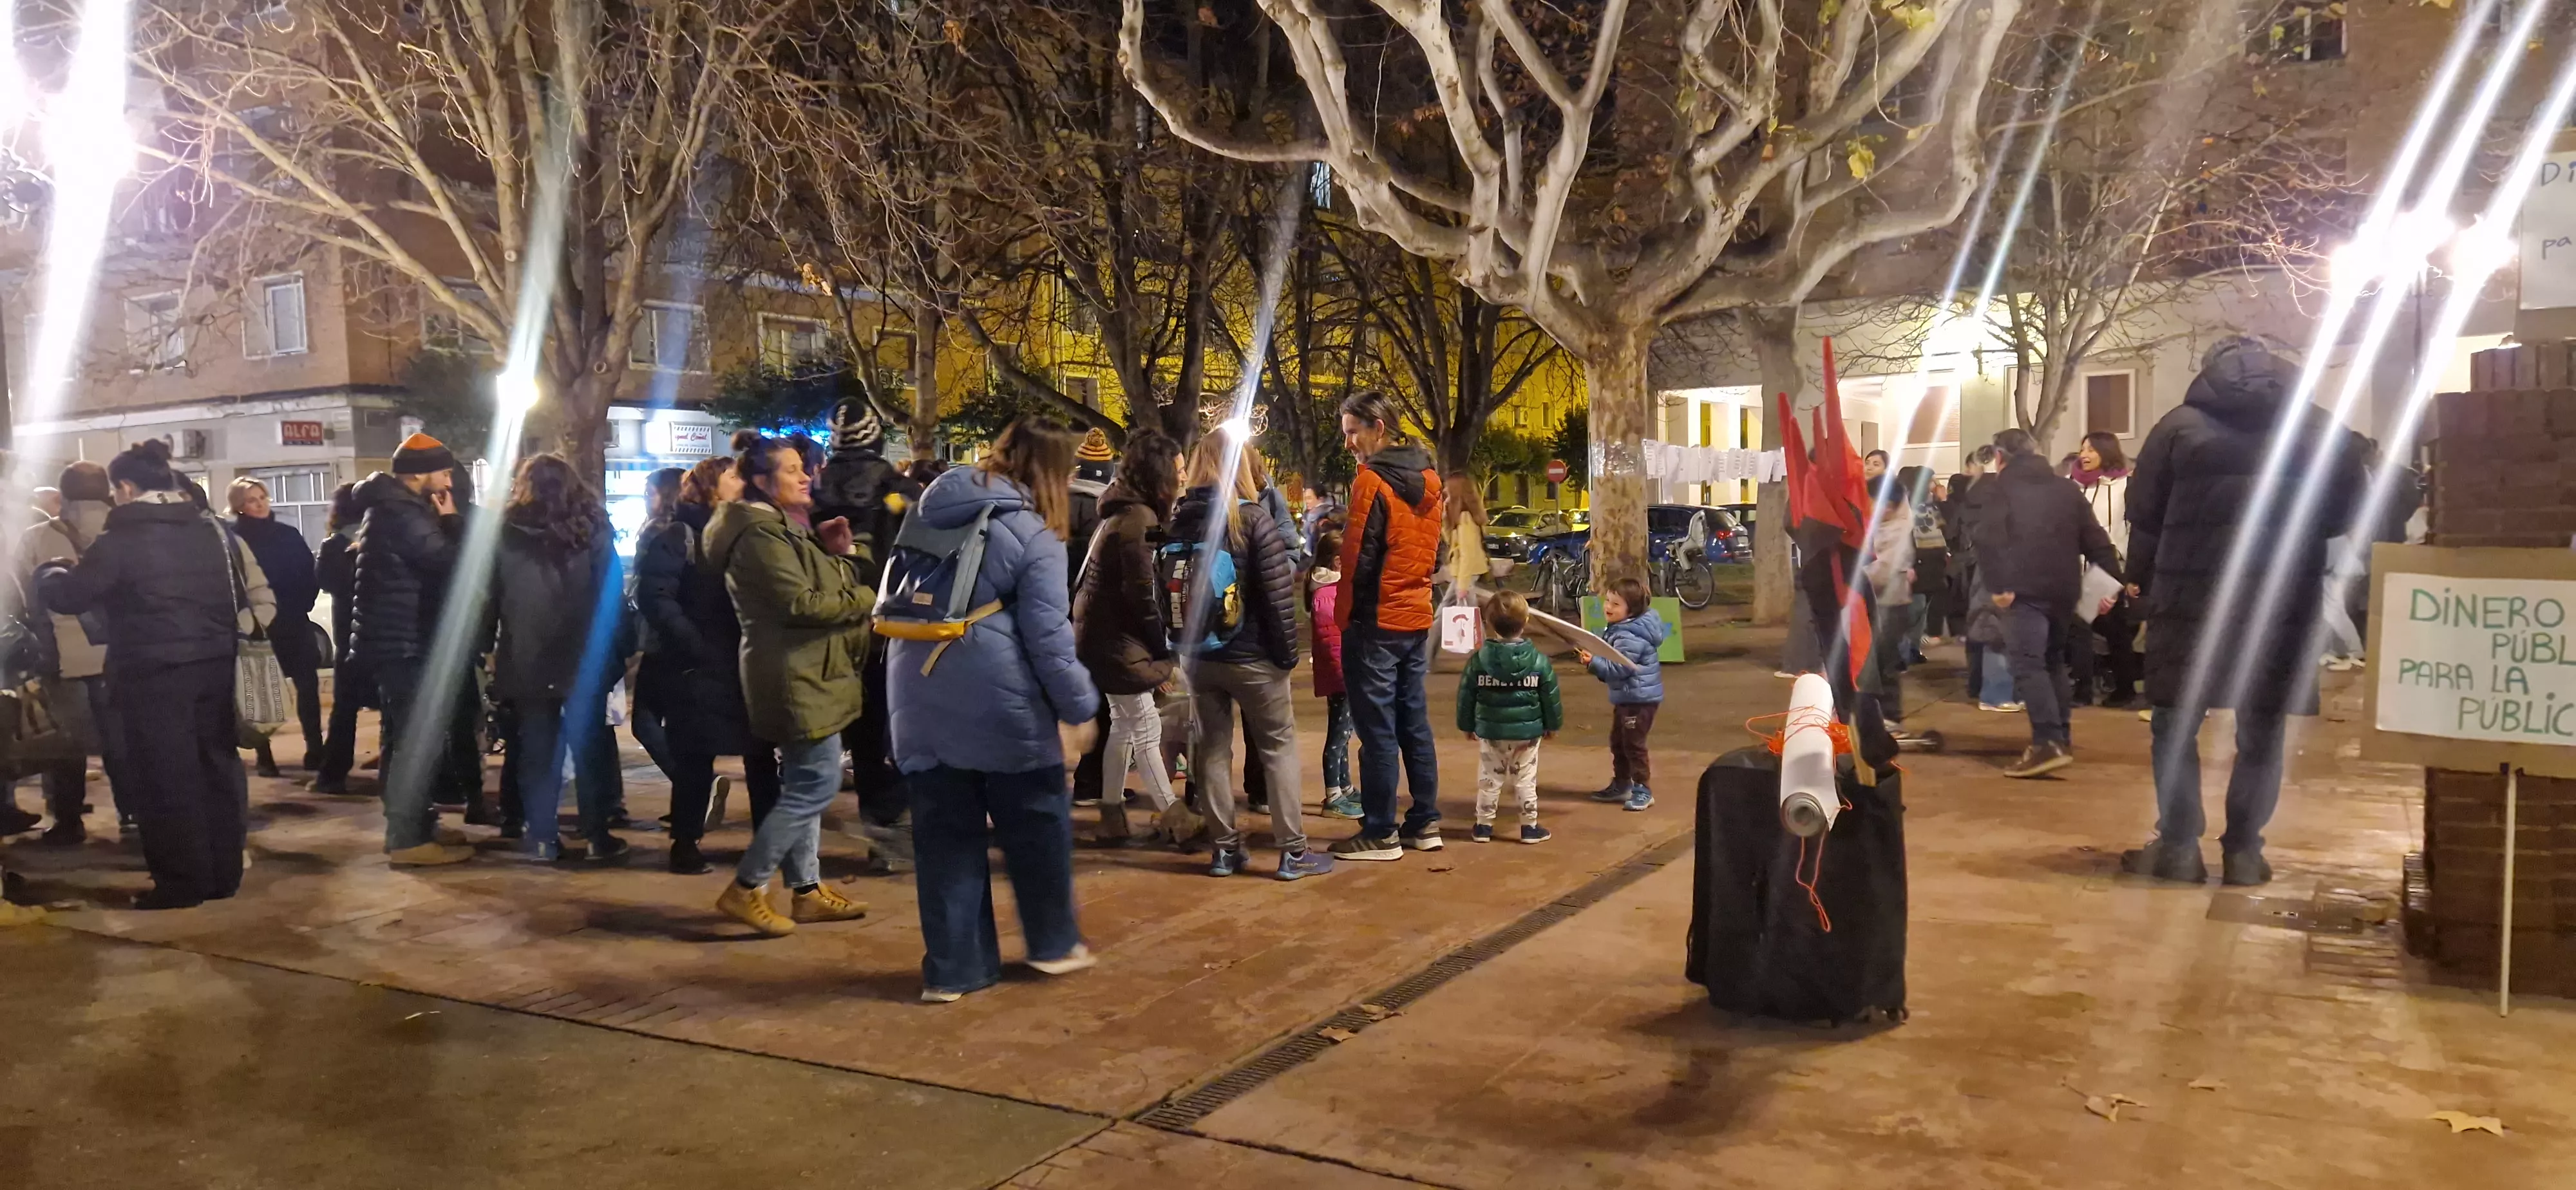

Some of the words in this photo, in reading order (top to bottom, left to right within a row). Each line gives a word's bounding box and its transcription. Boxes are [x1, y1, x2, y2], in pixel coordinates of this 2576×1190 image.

[1478, 675, 1539, 687] BENON
[2398, 658, 2474, 691] PARA
[2490, 664, 2530, 695] LA
